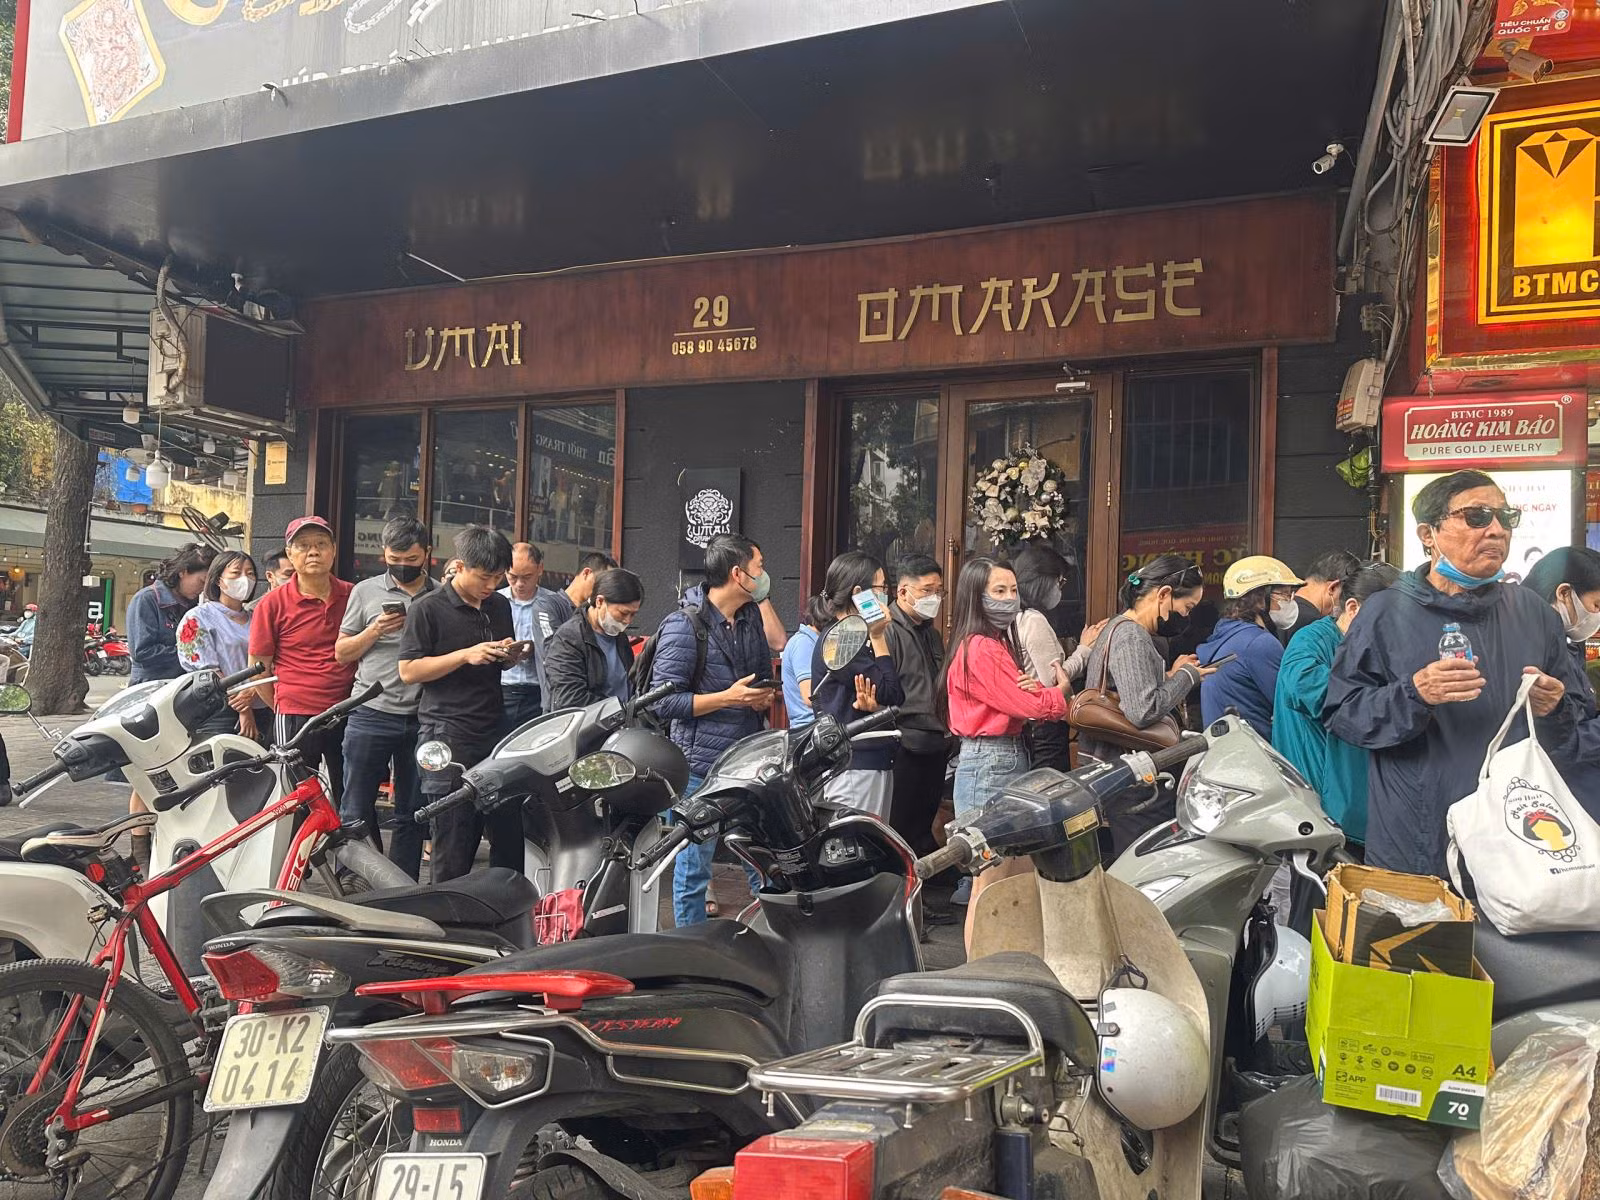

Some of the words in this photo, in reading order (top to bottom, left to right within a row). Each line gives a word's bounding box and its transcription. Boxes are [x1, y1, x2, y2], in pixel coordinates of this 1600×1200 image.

[1513, 269, 1599, 298] BTMC
[857, 257, 1203, 343] OMAKASE
[693, 295, 729, 328] 29
[405, 321, 521, 371] UMAI
[672, 341, 694, 355] 058
[698, 339, 713, 353] 90
[717, 336, 757, 352] 45678
[1451, 410, 1485, 419] BTMC
[1487, 408, 1514, 418] 1989
[1410, 418, 1474, 440] HOÀNG
[1475, 419, 1511, 437] KIM
[1515, 414, 1556, 435] BẢO
[1422, 446, 1451, 455] PURE
[1454, 445, 1487, 454] GOLD
[1490, 442, 1543, 453] JEWELRY
[233, 1014, 311, 1060] 30-K2
[221, 1057, 300, 1103] 0414
[1349, 1075, 1367, 1083] APP
[1452, 1064, 1477, 1078] A4
[1448, 1101, 1470, 1116] 70
[429, 1138, 463, 1146] HONDA
